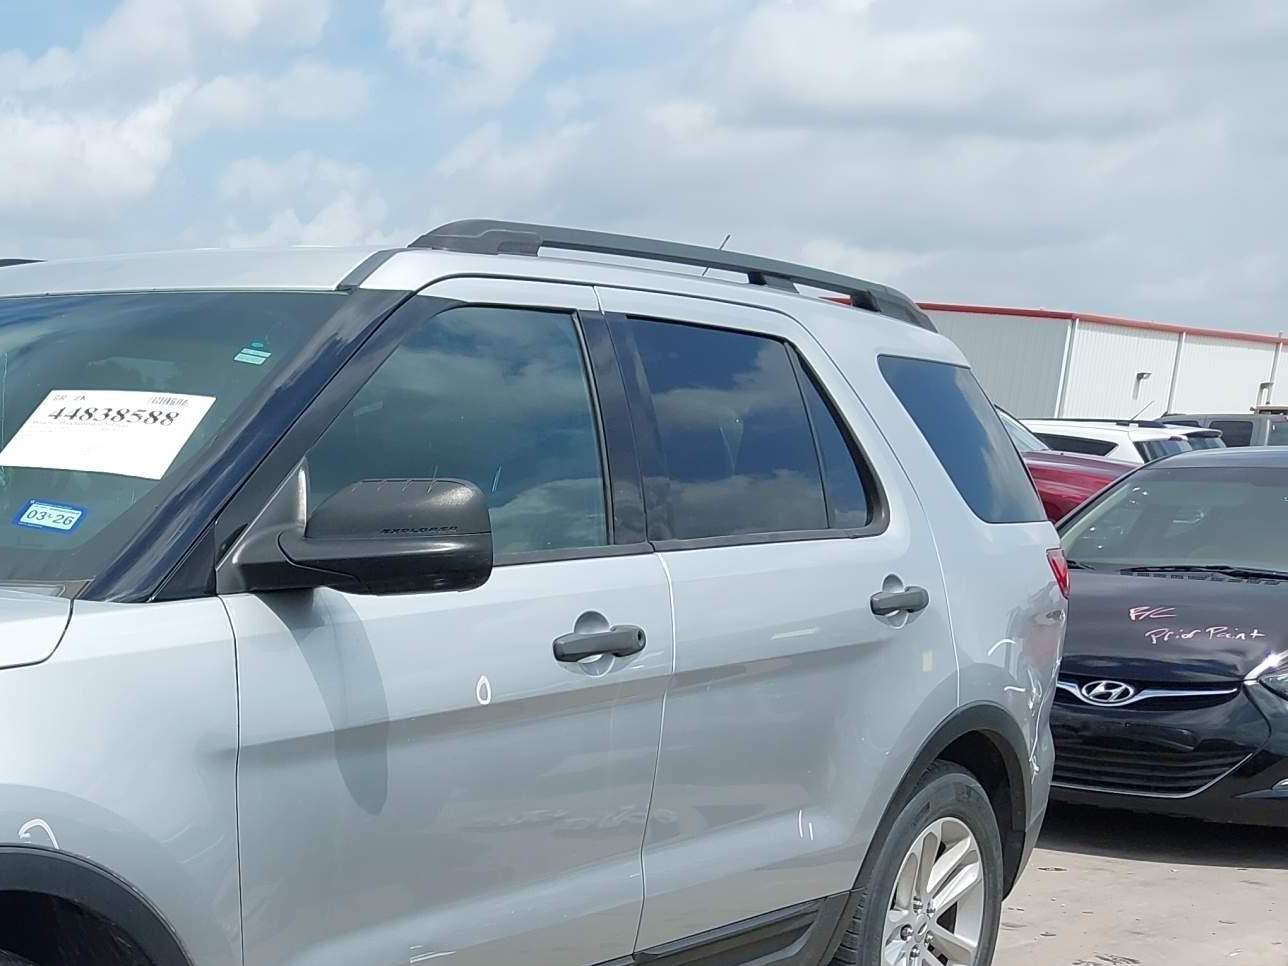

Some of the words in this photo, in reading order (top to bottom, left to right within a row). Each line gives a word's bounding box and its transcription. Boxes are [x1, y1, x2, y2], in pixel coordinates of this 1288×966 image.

[47, 406, 180, 427] 44838588
[26, 509, 47, 521] 03
[51, 514, 74, 526] 26
[1145, 626, 1201, 644] Prior
